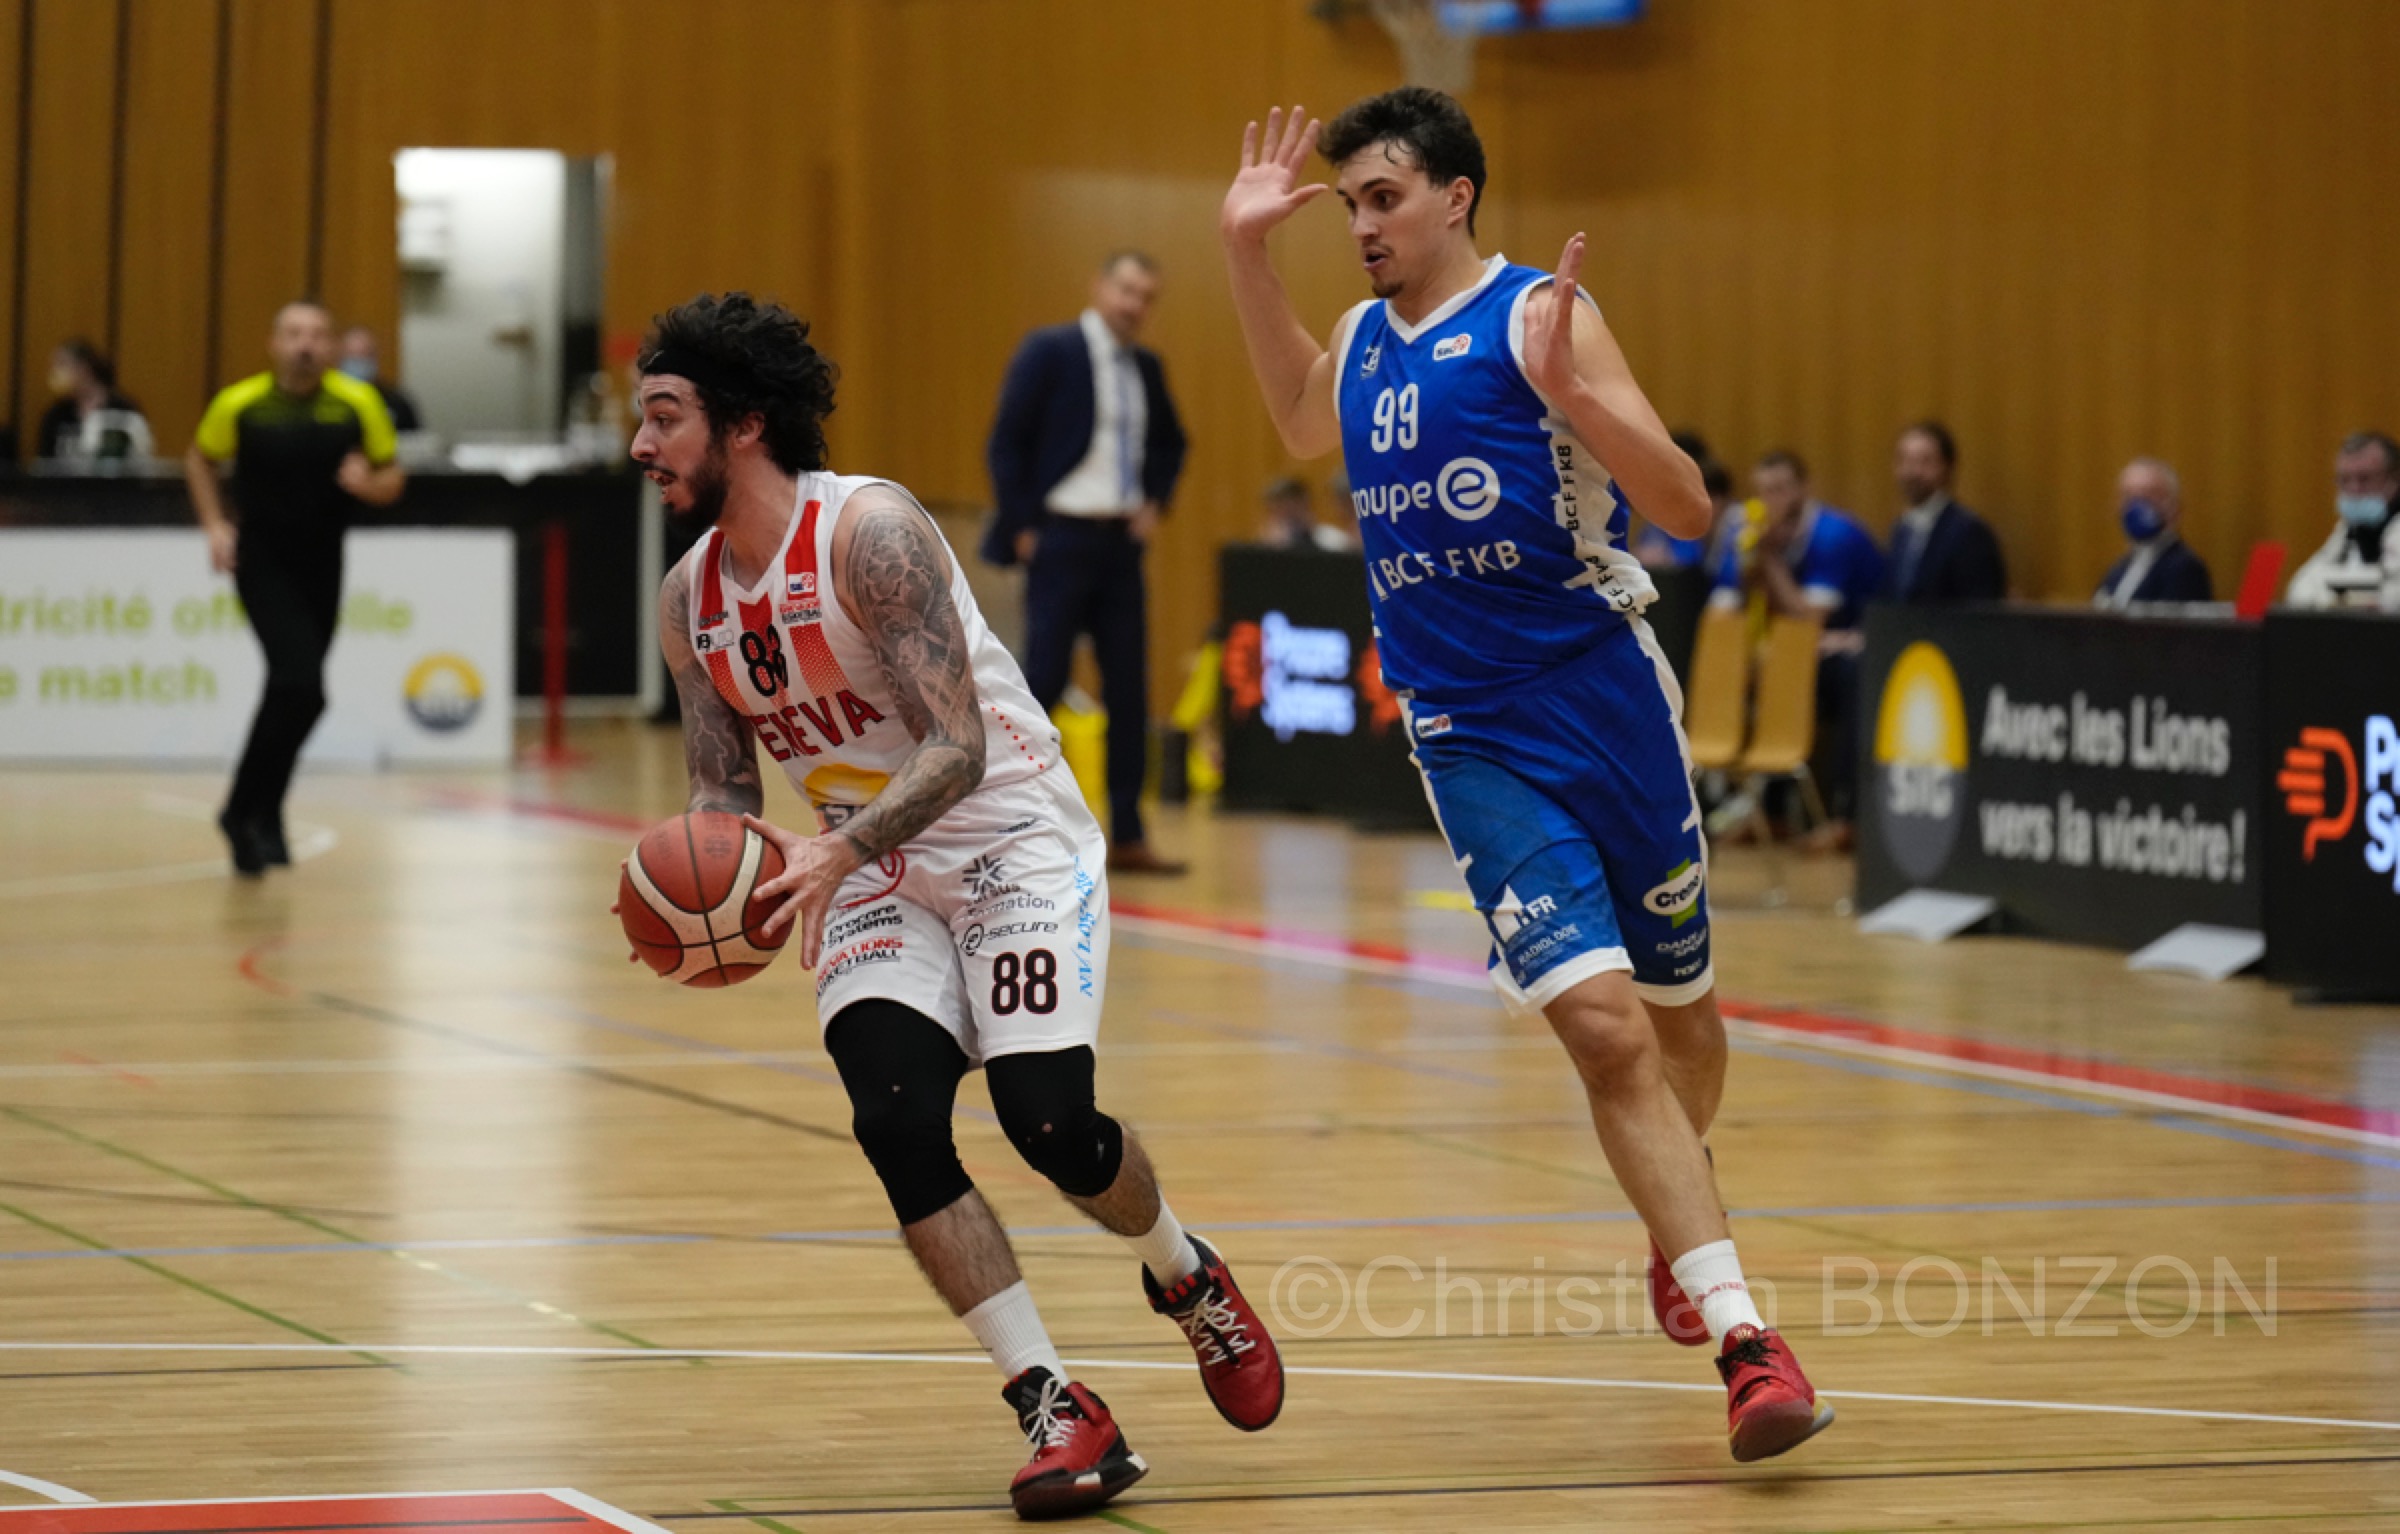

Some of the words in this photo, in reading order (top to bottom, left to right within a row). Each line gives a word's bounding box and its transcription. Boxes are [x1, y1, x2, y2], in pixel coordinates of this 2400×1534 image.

[1371, 383, 1419, 453] 99
[1556, 445, 1575, 485] FKB
[1563, 491, 1580, 531] BCF
[1378, 552, 1436, 591] BCF
[1445, 539, 1521, 579] FKB
[38, 660, 219, 706] match
[740, 623, 788, 698] 88
[1982, 683, 2067, 763] Avec
[2071, 690, 2125, 768] les
[2130, 694, 2230, 776] Lions
[1980, 800, 2053, 862] vers
[2057, 791, 2092, 866] la
[991, 948, 1058, 1016] 88
